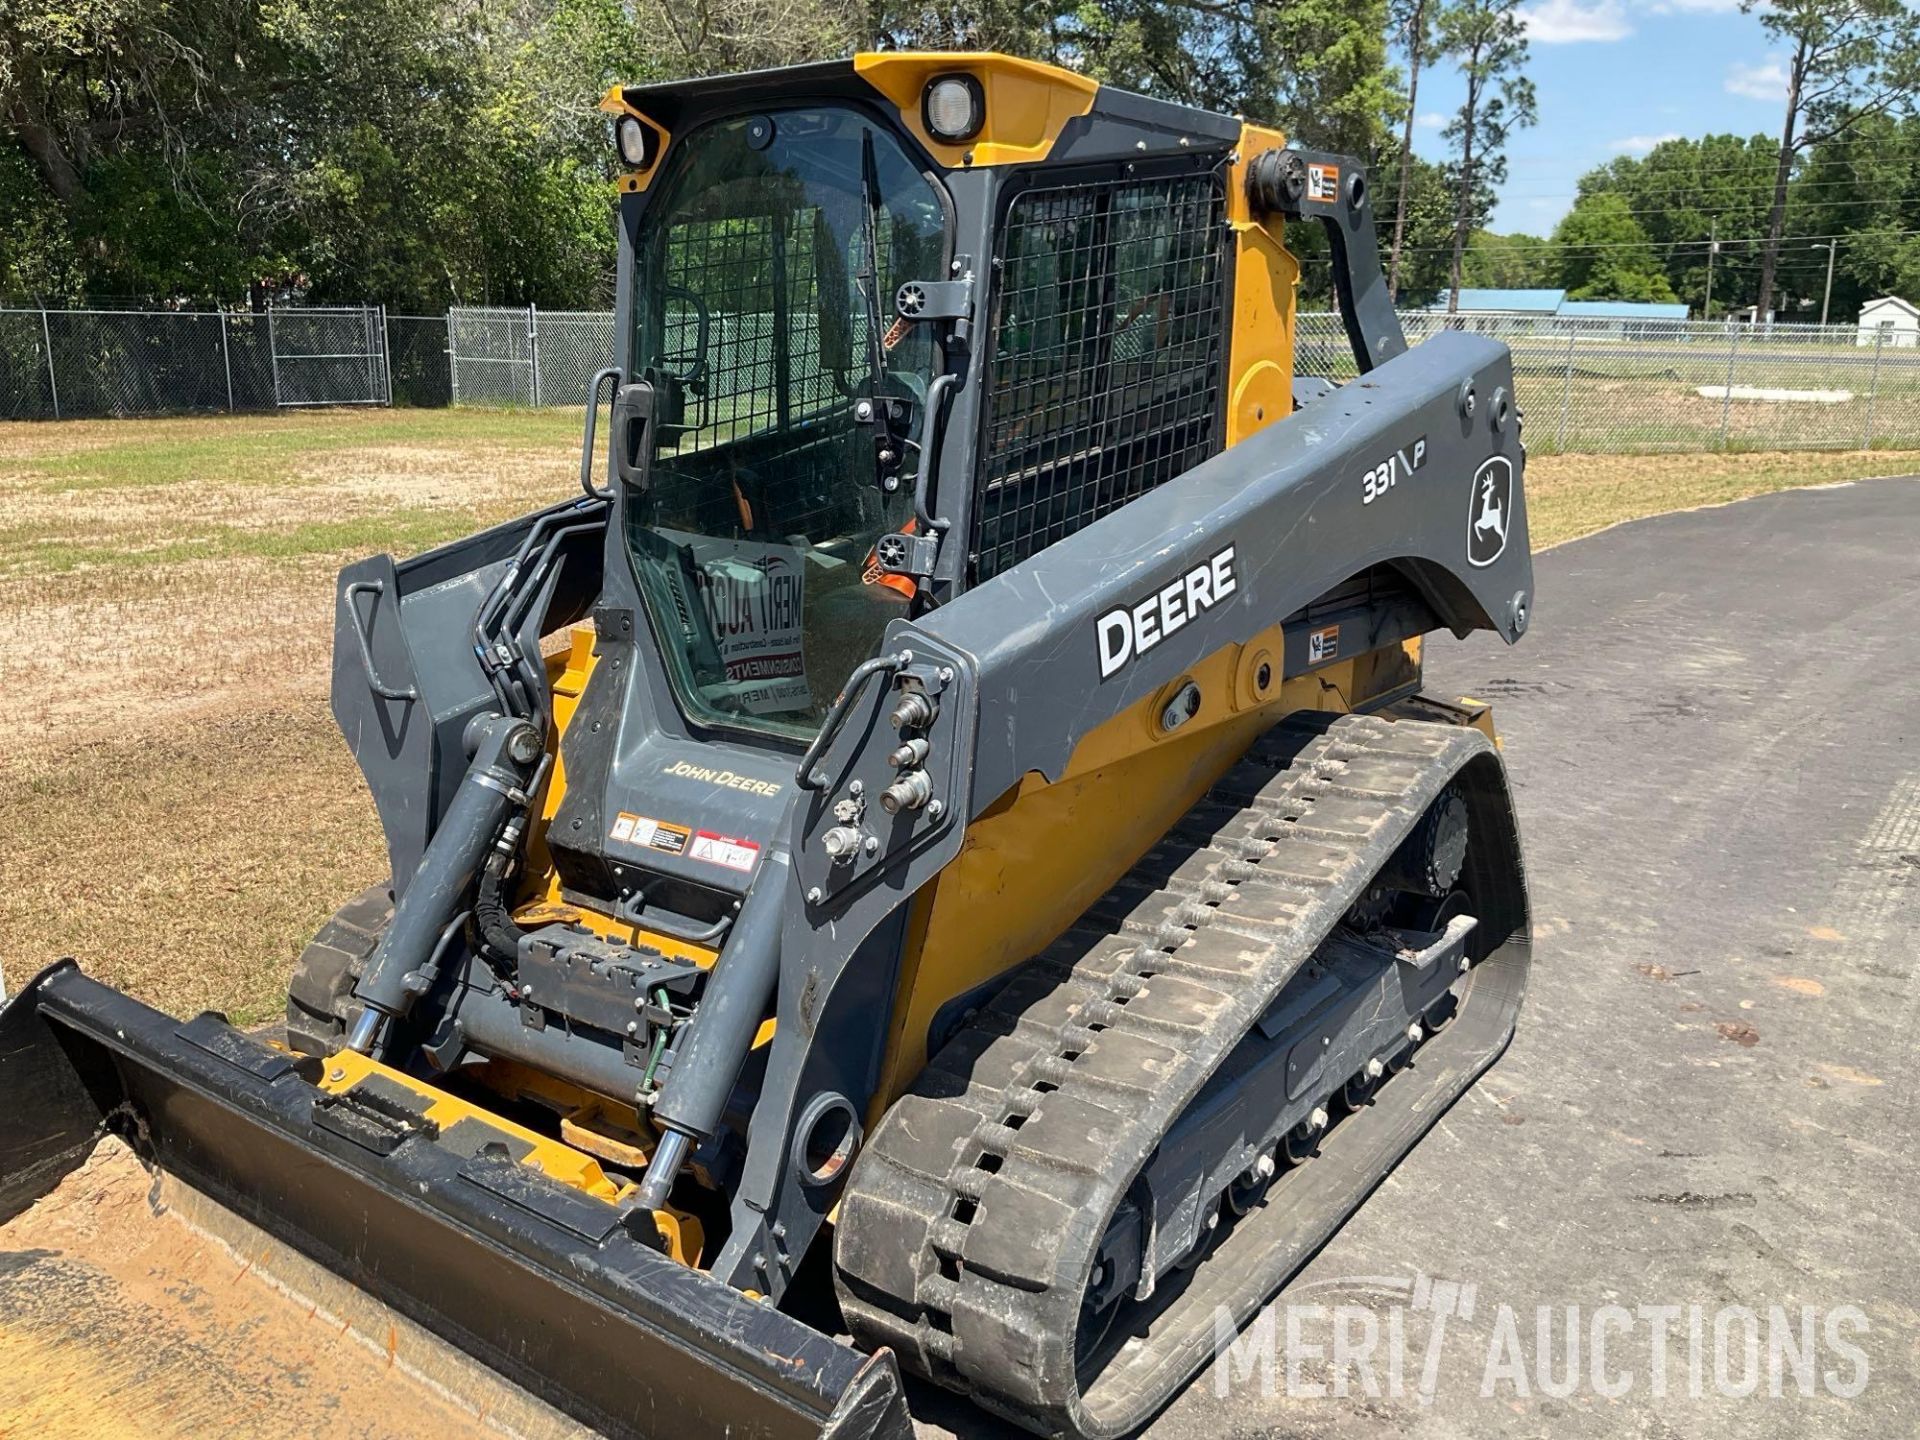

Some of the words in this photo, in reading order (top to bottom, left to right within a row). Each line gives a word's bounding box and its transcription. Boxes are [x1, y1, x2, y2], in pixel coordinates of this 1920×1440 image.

[1363, 456, 1395, 505] 331
[1096, 545, 1238, 679] DEERE
[663, 760, 718, 783] JOHN
[716, 771, 783, 797] DEERE
